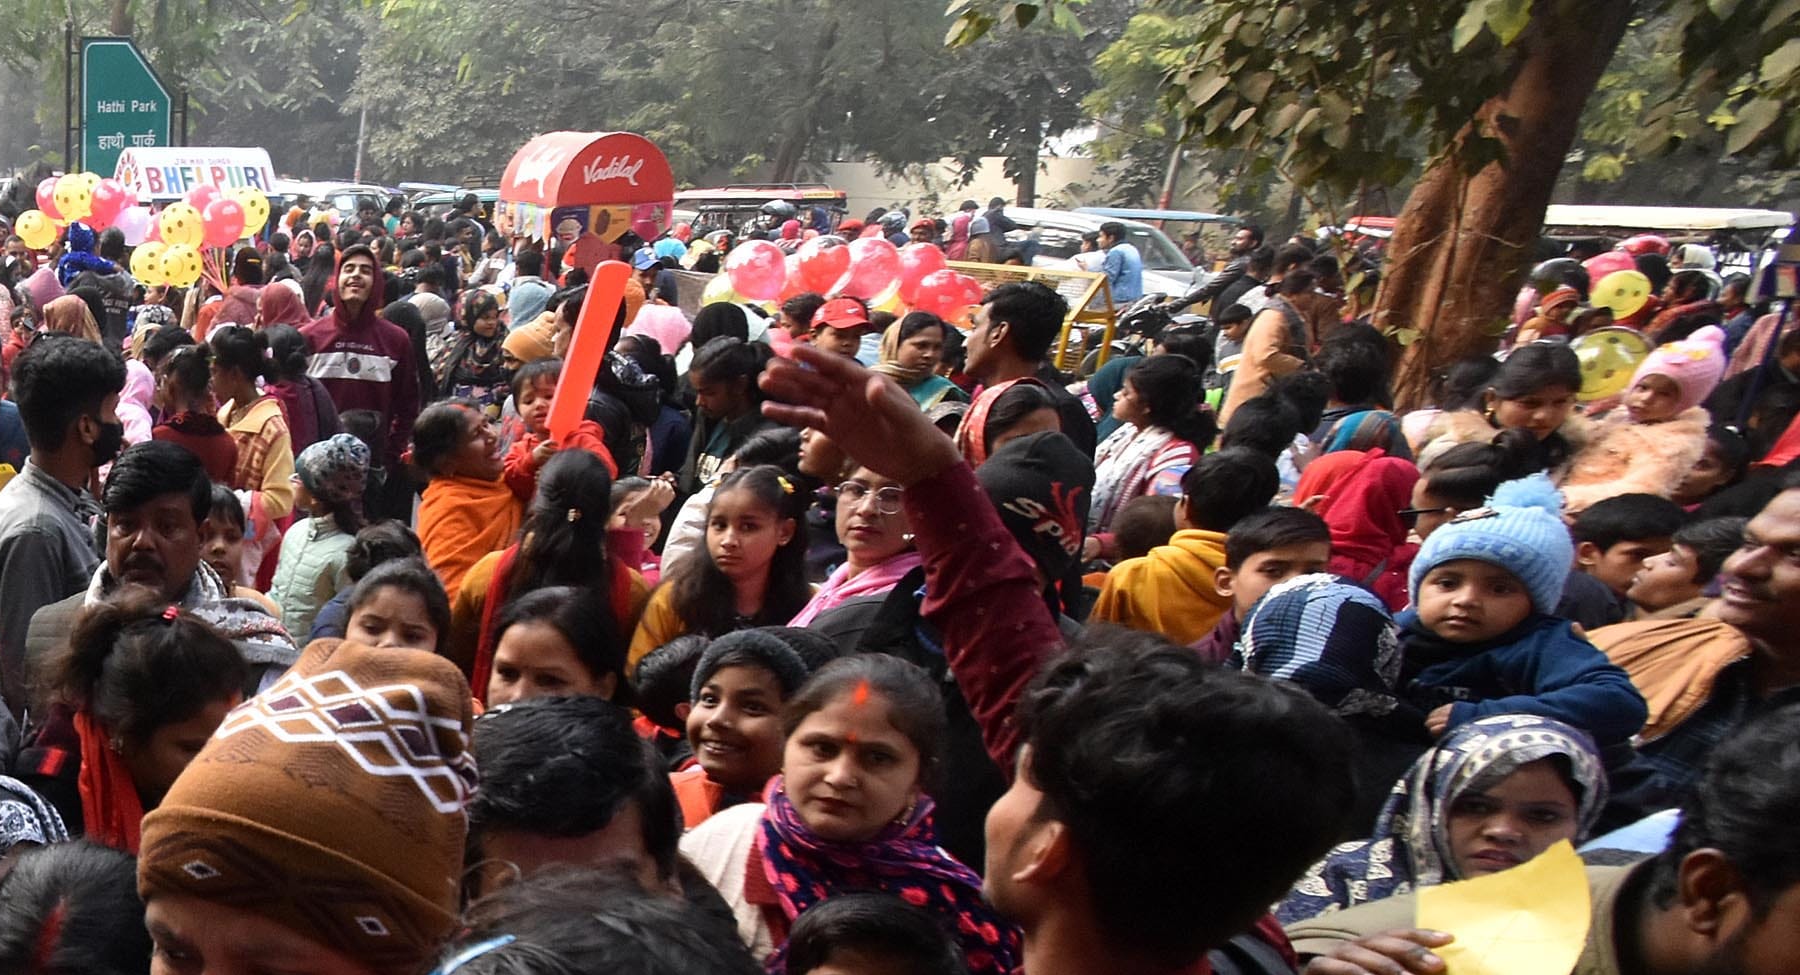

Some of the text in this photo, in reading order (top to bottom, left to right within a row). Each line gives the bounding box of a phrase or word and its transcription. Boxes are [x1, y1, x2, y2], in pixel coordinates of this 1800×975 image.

[97, 100, 157, 113] Hathi Park
[97, 129, 156, 150] हाथी पार्क
[210, 166, 272, 193] PURI
[584, 155, 644, 186] Vadilal
